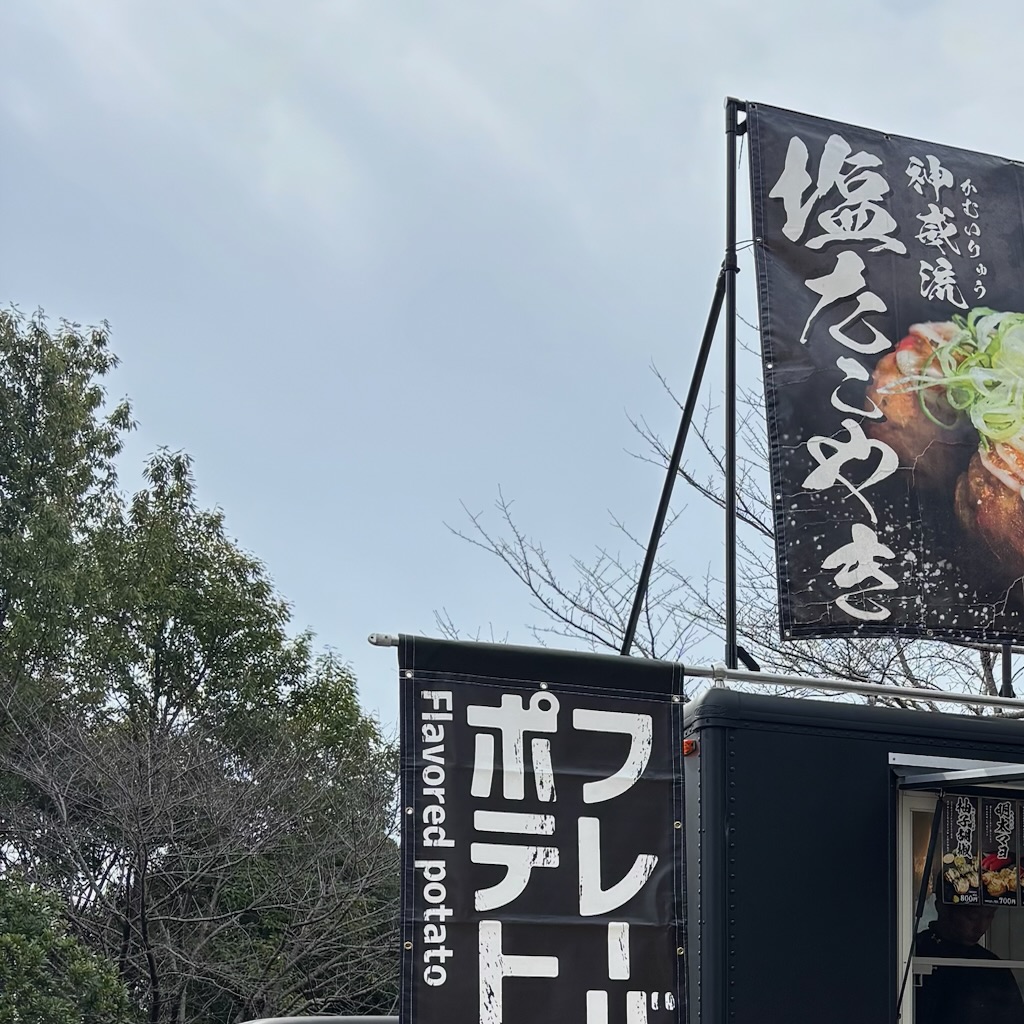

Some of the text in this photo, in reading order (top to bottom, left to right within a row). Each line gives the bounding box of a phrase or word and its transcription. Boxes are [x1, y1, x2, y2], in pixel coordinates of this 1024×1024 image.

[905, 154, 968, 311] 神威流
[960, 178, 988, 300] かむいりゅう
[769, 133, 906, 621] 塩たこやき
[415, 690, 455, 987] Flavored potato
[998, 897, 1016, 906] 700円
